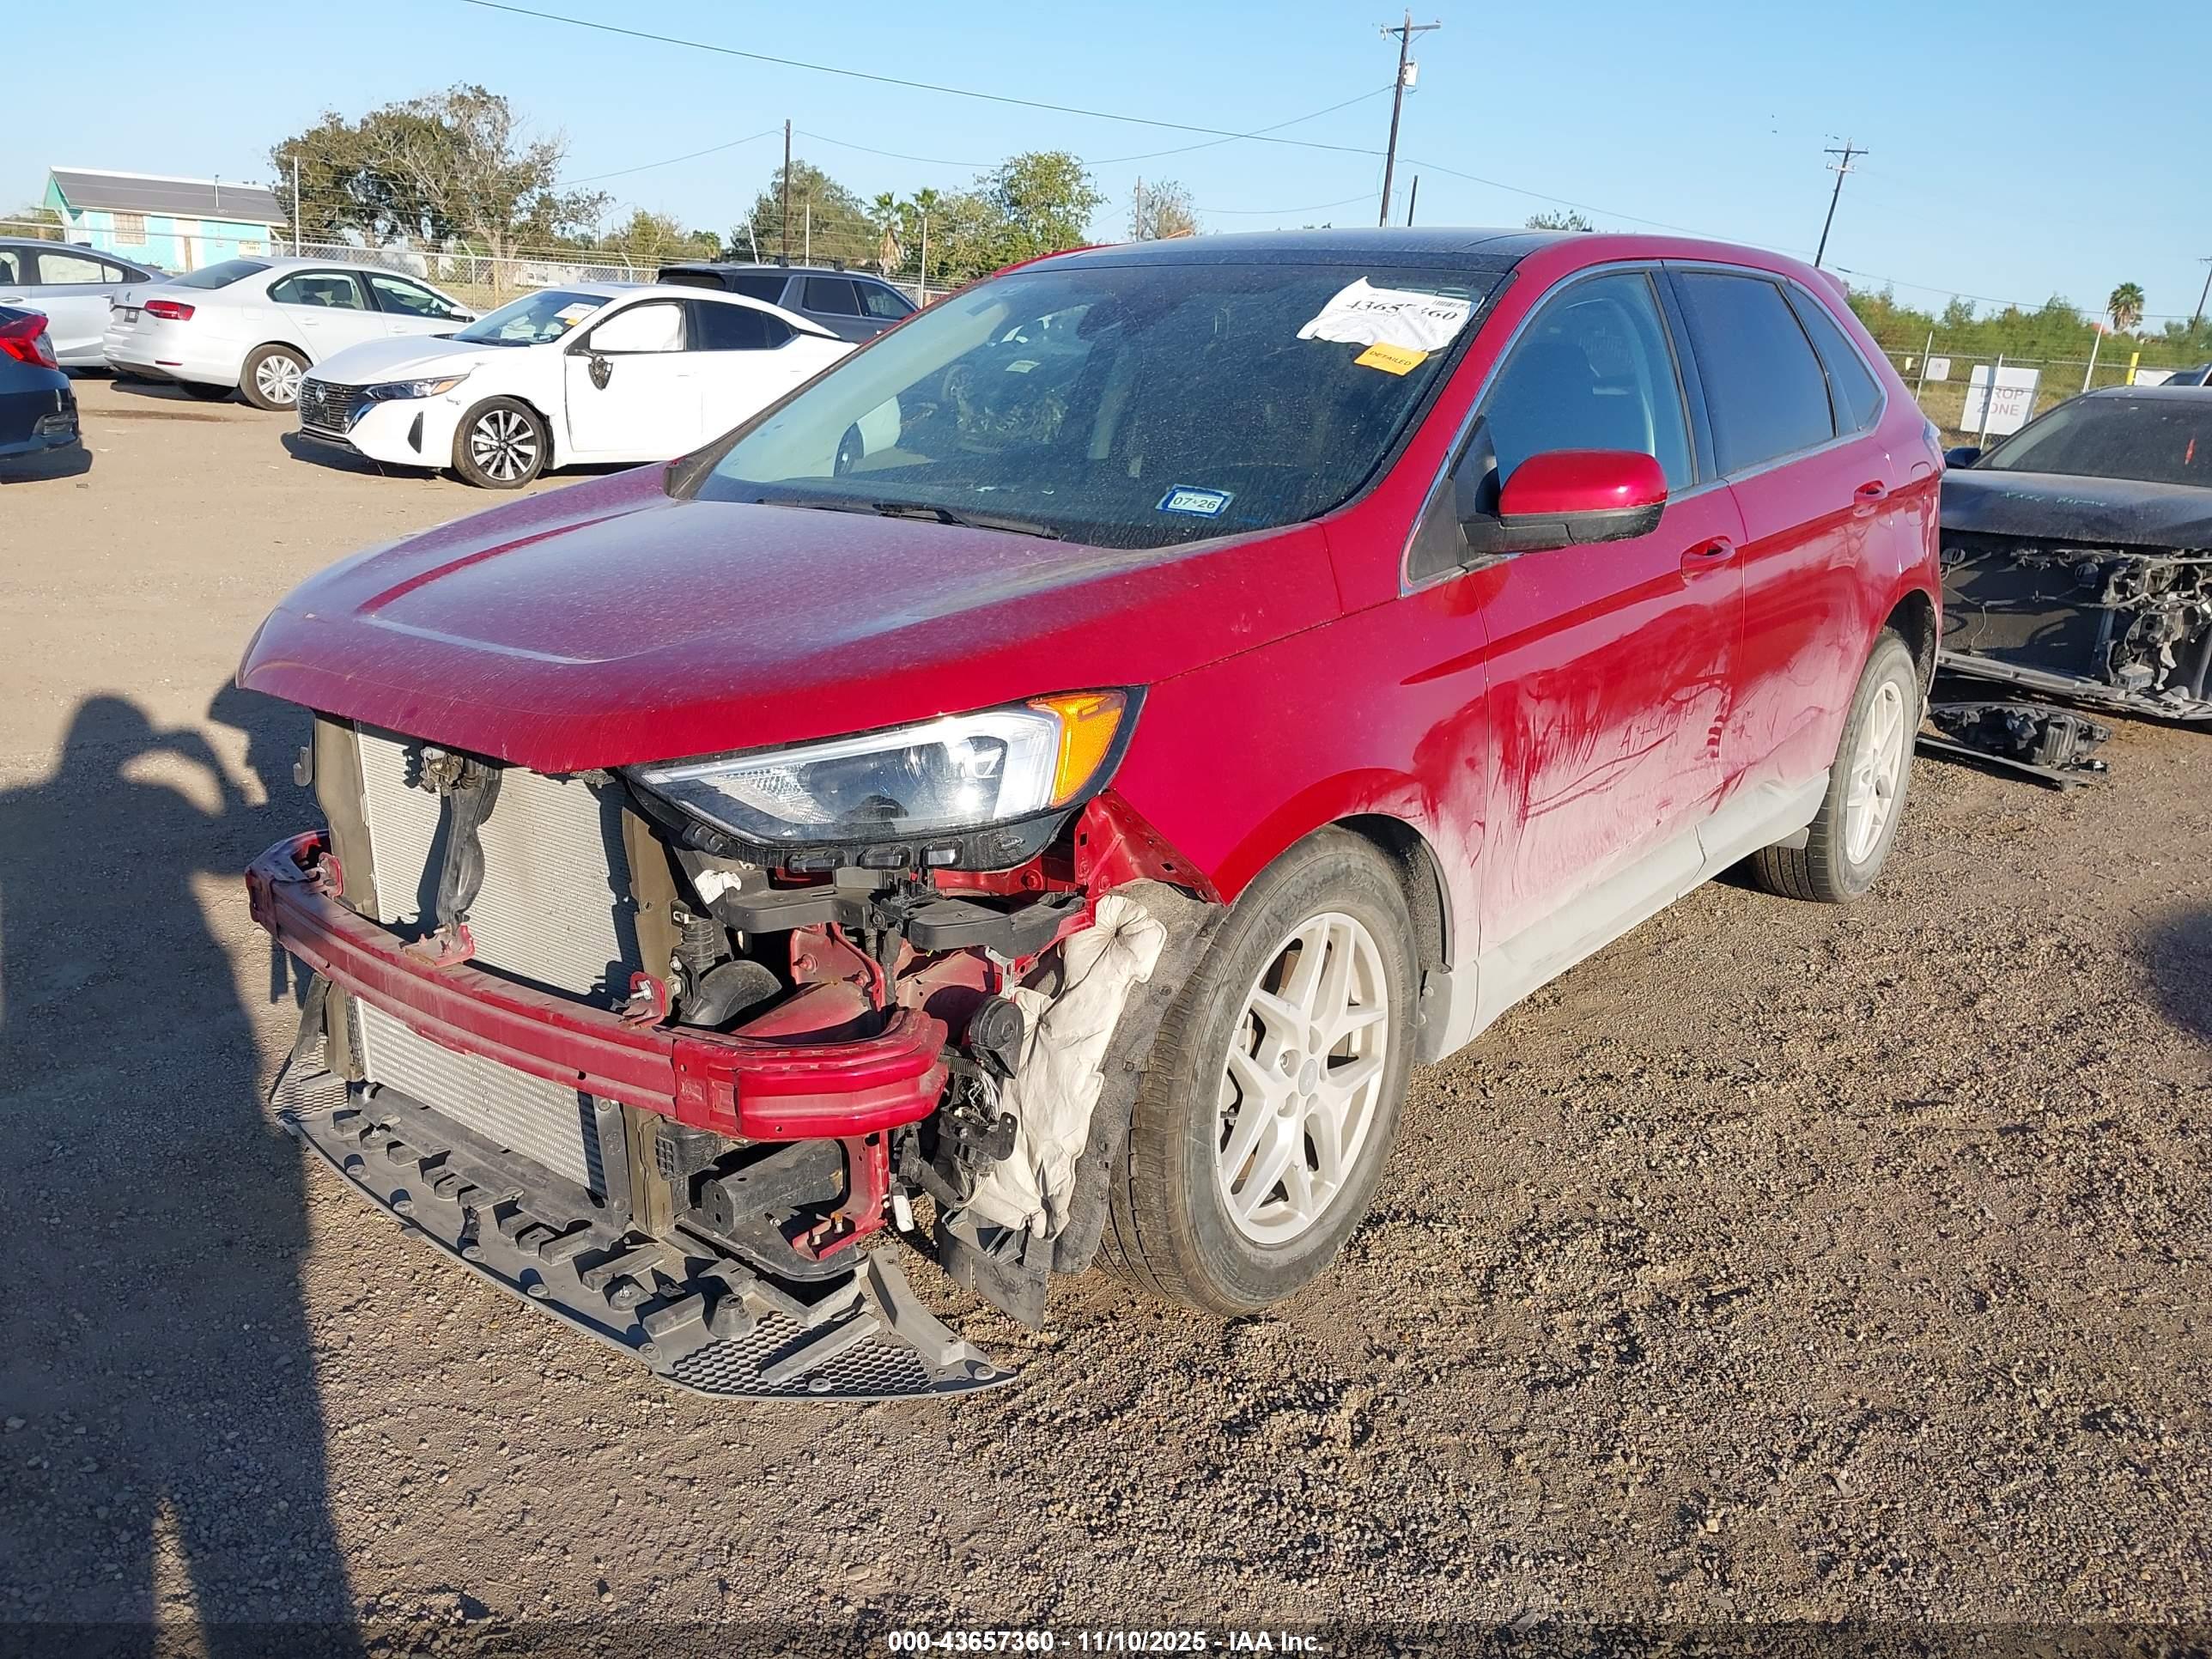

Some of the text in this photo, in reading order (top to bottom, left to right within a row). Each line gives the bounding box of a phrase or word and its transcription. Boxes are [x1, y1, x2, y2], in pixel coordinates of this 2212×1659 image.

[1369, 350, 1413, 366] DETAILED
[1979, 386, 2025, 401] DROP
[1977, 402, 2021, 416] ZONE
